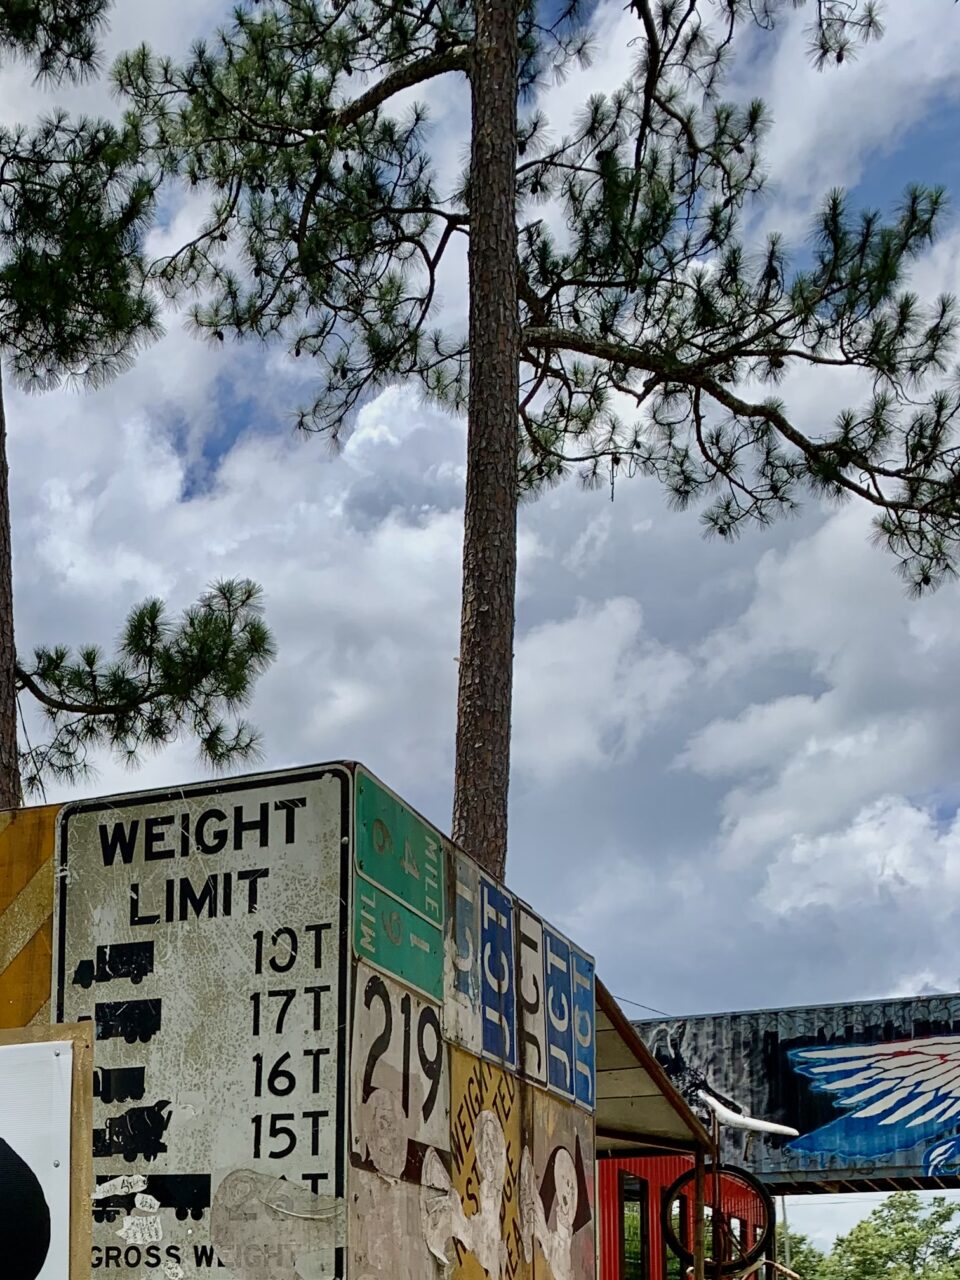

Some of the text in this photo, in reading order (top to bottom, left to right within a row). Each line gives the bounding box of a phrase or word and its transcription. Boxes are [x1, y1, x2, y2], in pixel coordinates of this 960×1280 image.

[99, 797, 307, 867] WEIGHT
[130, 868, 270, 926] LIMIT
[425, 836, 439, 917] MILE
[484, 886, 510, 1056] JCT
[250, 985, 331, 1036] 17T
[547, 937, 570, 1089] JCT
[573, 957, 592, 1099] JCT
[252, 1048, 330, 1097] 16T
[362, 974, 443, 1124] 219
[251, 1111, 329, 1159] 15T
[91, 1245, 181, 1267] GROSS
